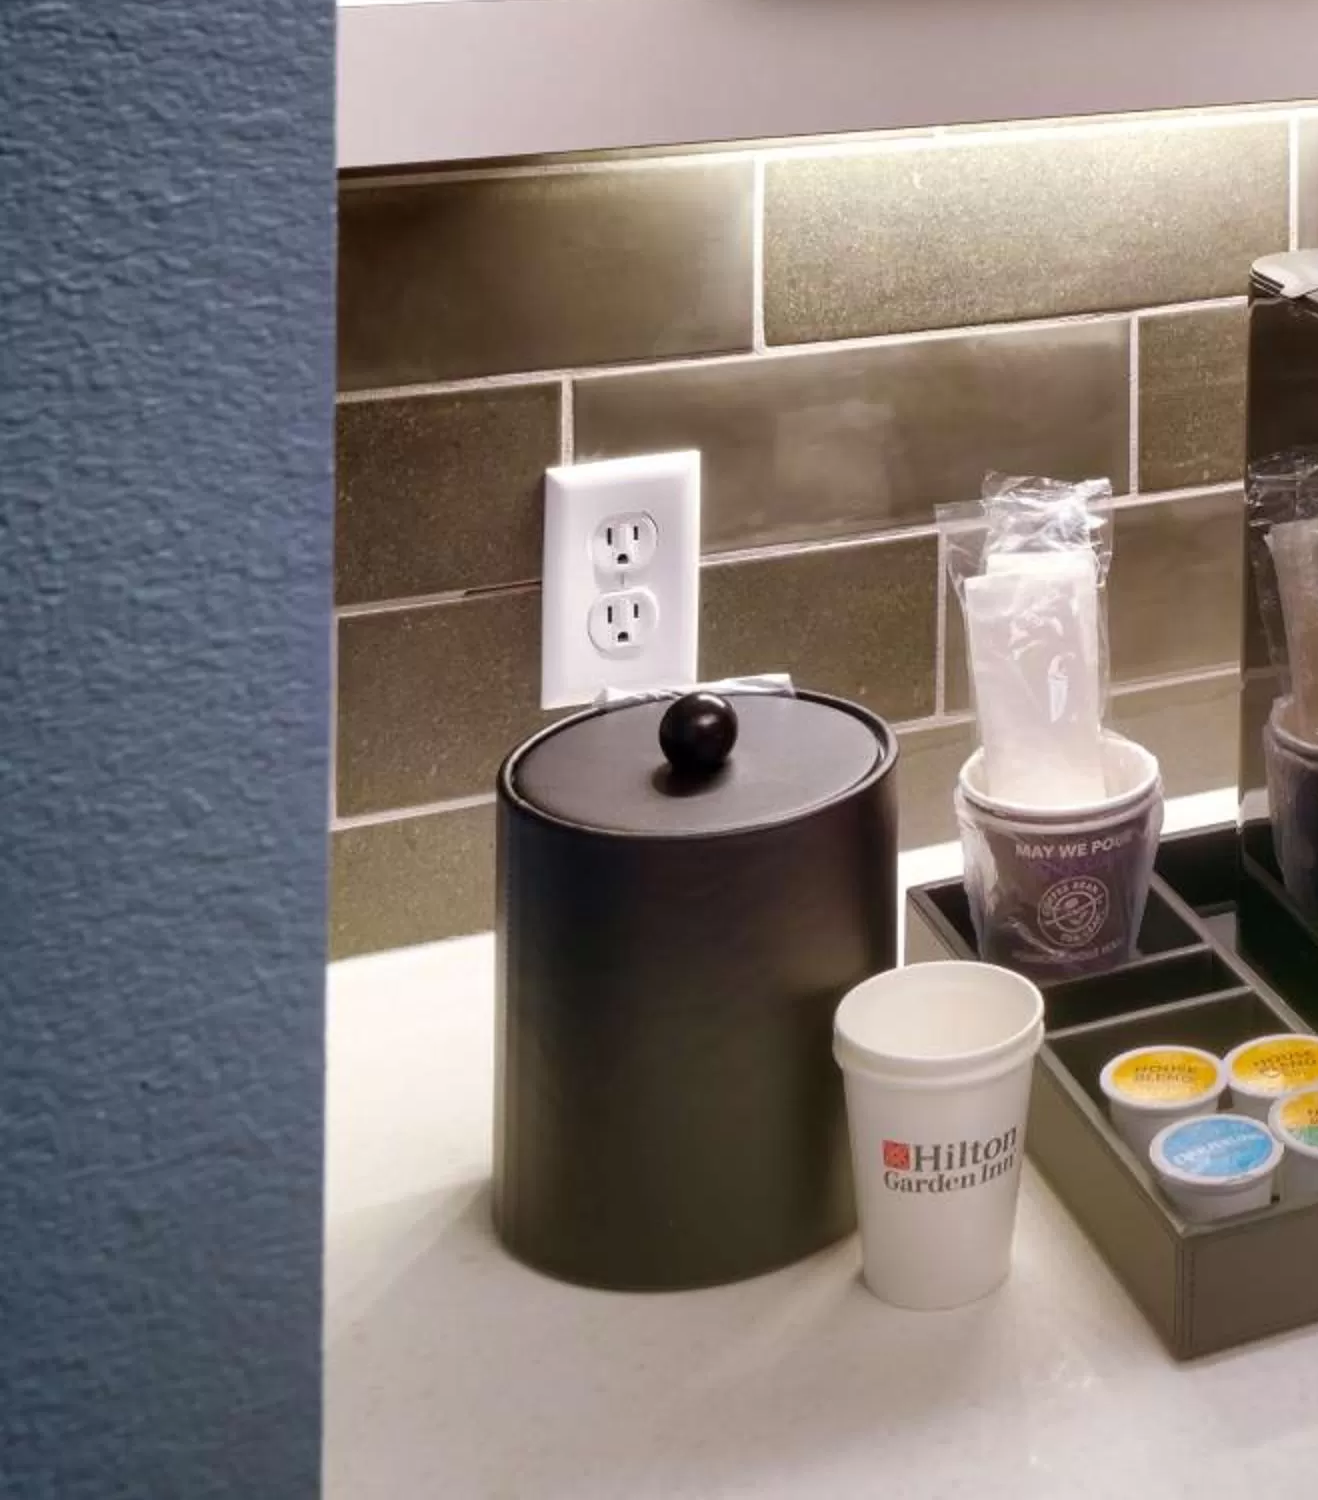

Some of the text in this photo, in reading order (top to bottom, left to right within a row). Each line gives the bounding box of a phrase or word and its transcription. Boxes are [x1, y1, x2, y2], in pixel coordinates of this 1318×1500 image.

[1015, 844, 1055, 859] MAY
[1059, 843, 1089, 860] WE
[915, 1127, 1017, 1172] Hilton
[883, 1154, 1014, 1194] Garden Inn
